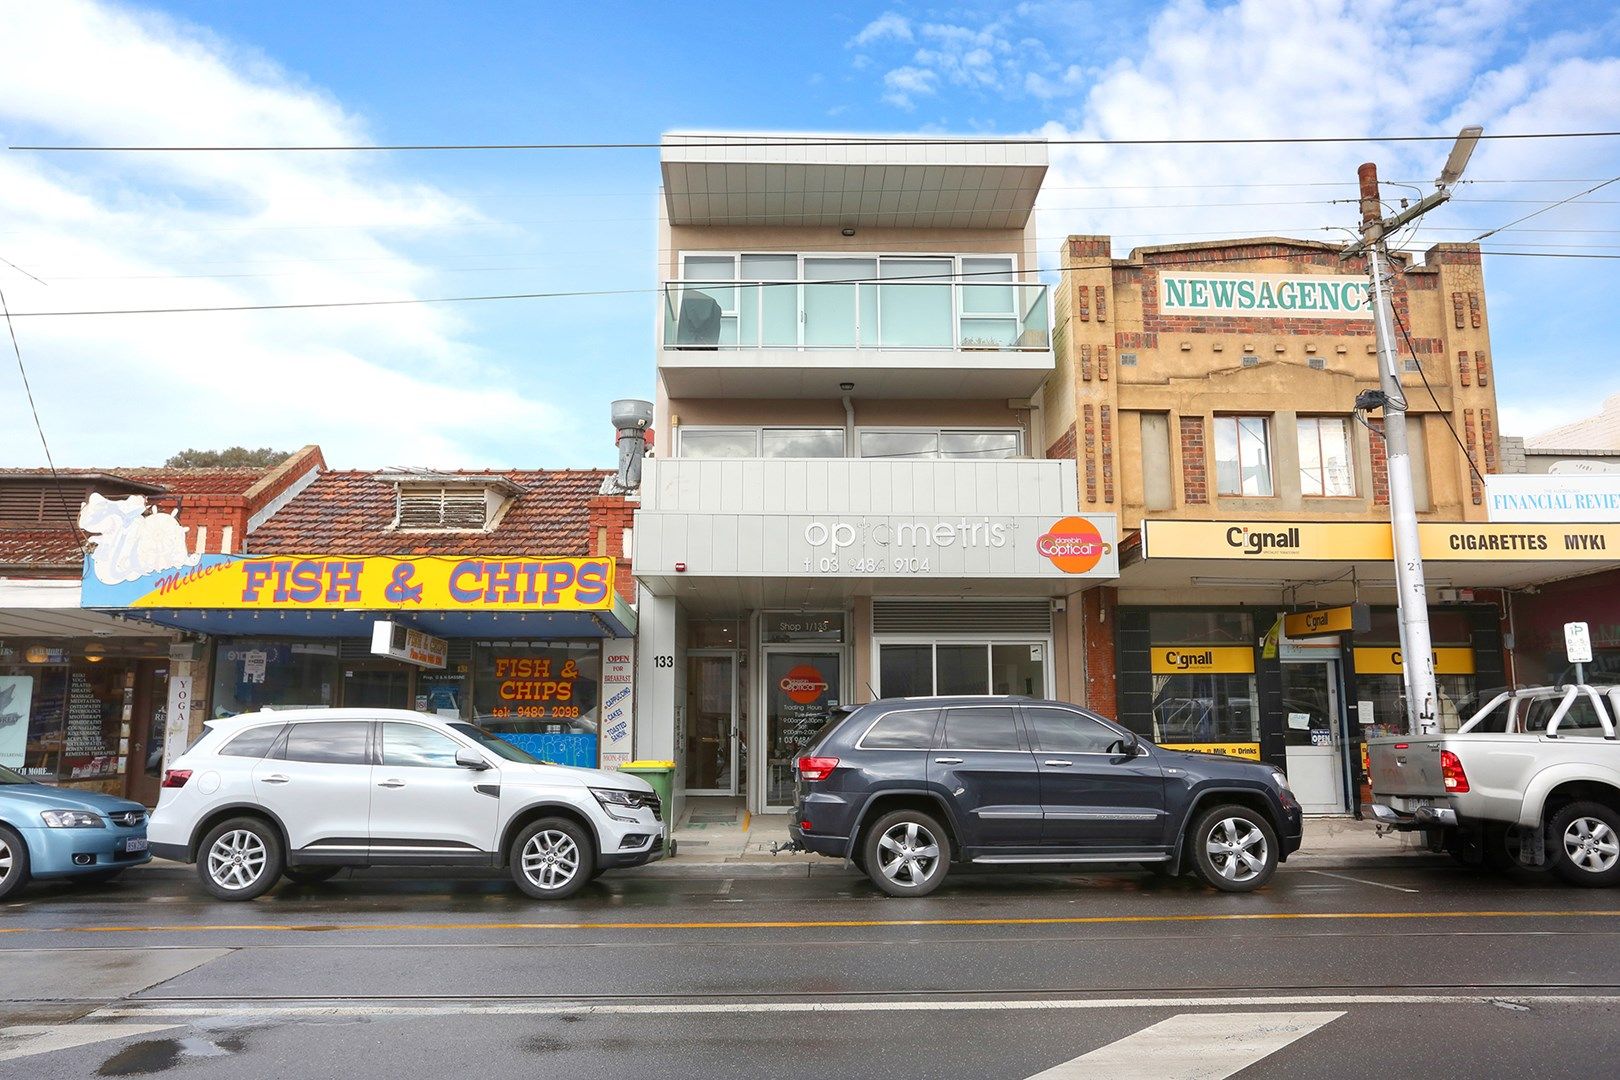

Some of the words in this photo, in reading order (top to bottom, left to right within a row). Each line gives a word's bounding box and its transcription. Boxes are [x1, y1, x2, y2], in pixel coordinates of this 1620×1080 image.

[1494, 494, 1572, 510] FINANCIAL
[1575, 493, 1620, 509] REVIE
[804, 516, 1019, 556] optometrist
[1226, 527, 1300, 555] Cignall
[1449, 534, 1548, 550] CIGARETTES
[1564, 534, 1606, 550] MYKI
[820, 558, 840, 573] 03
[894, 558, 931, 573] 9104
[154, 558, 234, 596] Millers
[241, 560, 366, 604] FISH
[384, 562, 424, 604] &
[449, 560, 609, 604] CHIPS
[780, 622, 801, 632] Shop
[805, 622, 828, 631] 1/133
[1306, 612, 1329, 631] Cignall
[495, 658, 552, 678] FISH
[560, 659, 579, 679] &
[653, 655, 674, 668] 133
[1165, 651, 1213, 669] Cignall
[499, 680, 573, 701] CHIPS
[605, 686, 631, 708] CAPPUCCINO
[177, 680, 188, 721] YOGA
[492, 706, 511, 718] tel:
[517, 705, 545, 718] 9480
[552, 705, 579, 718] 2098
[607, 708, 623, 721] CAKES
[606, 720, 628, 736] TOASTED
